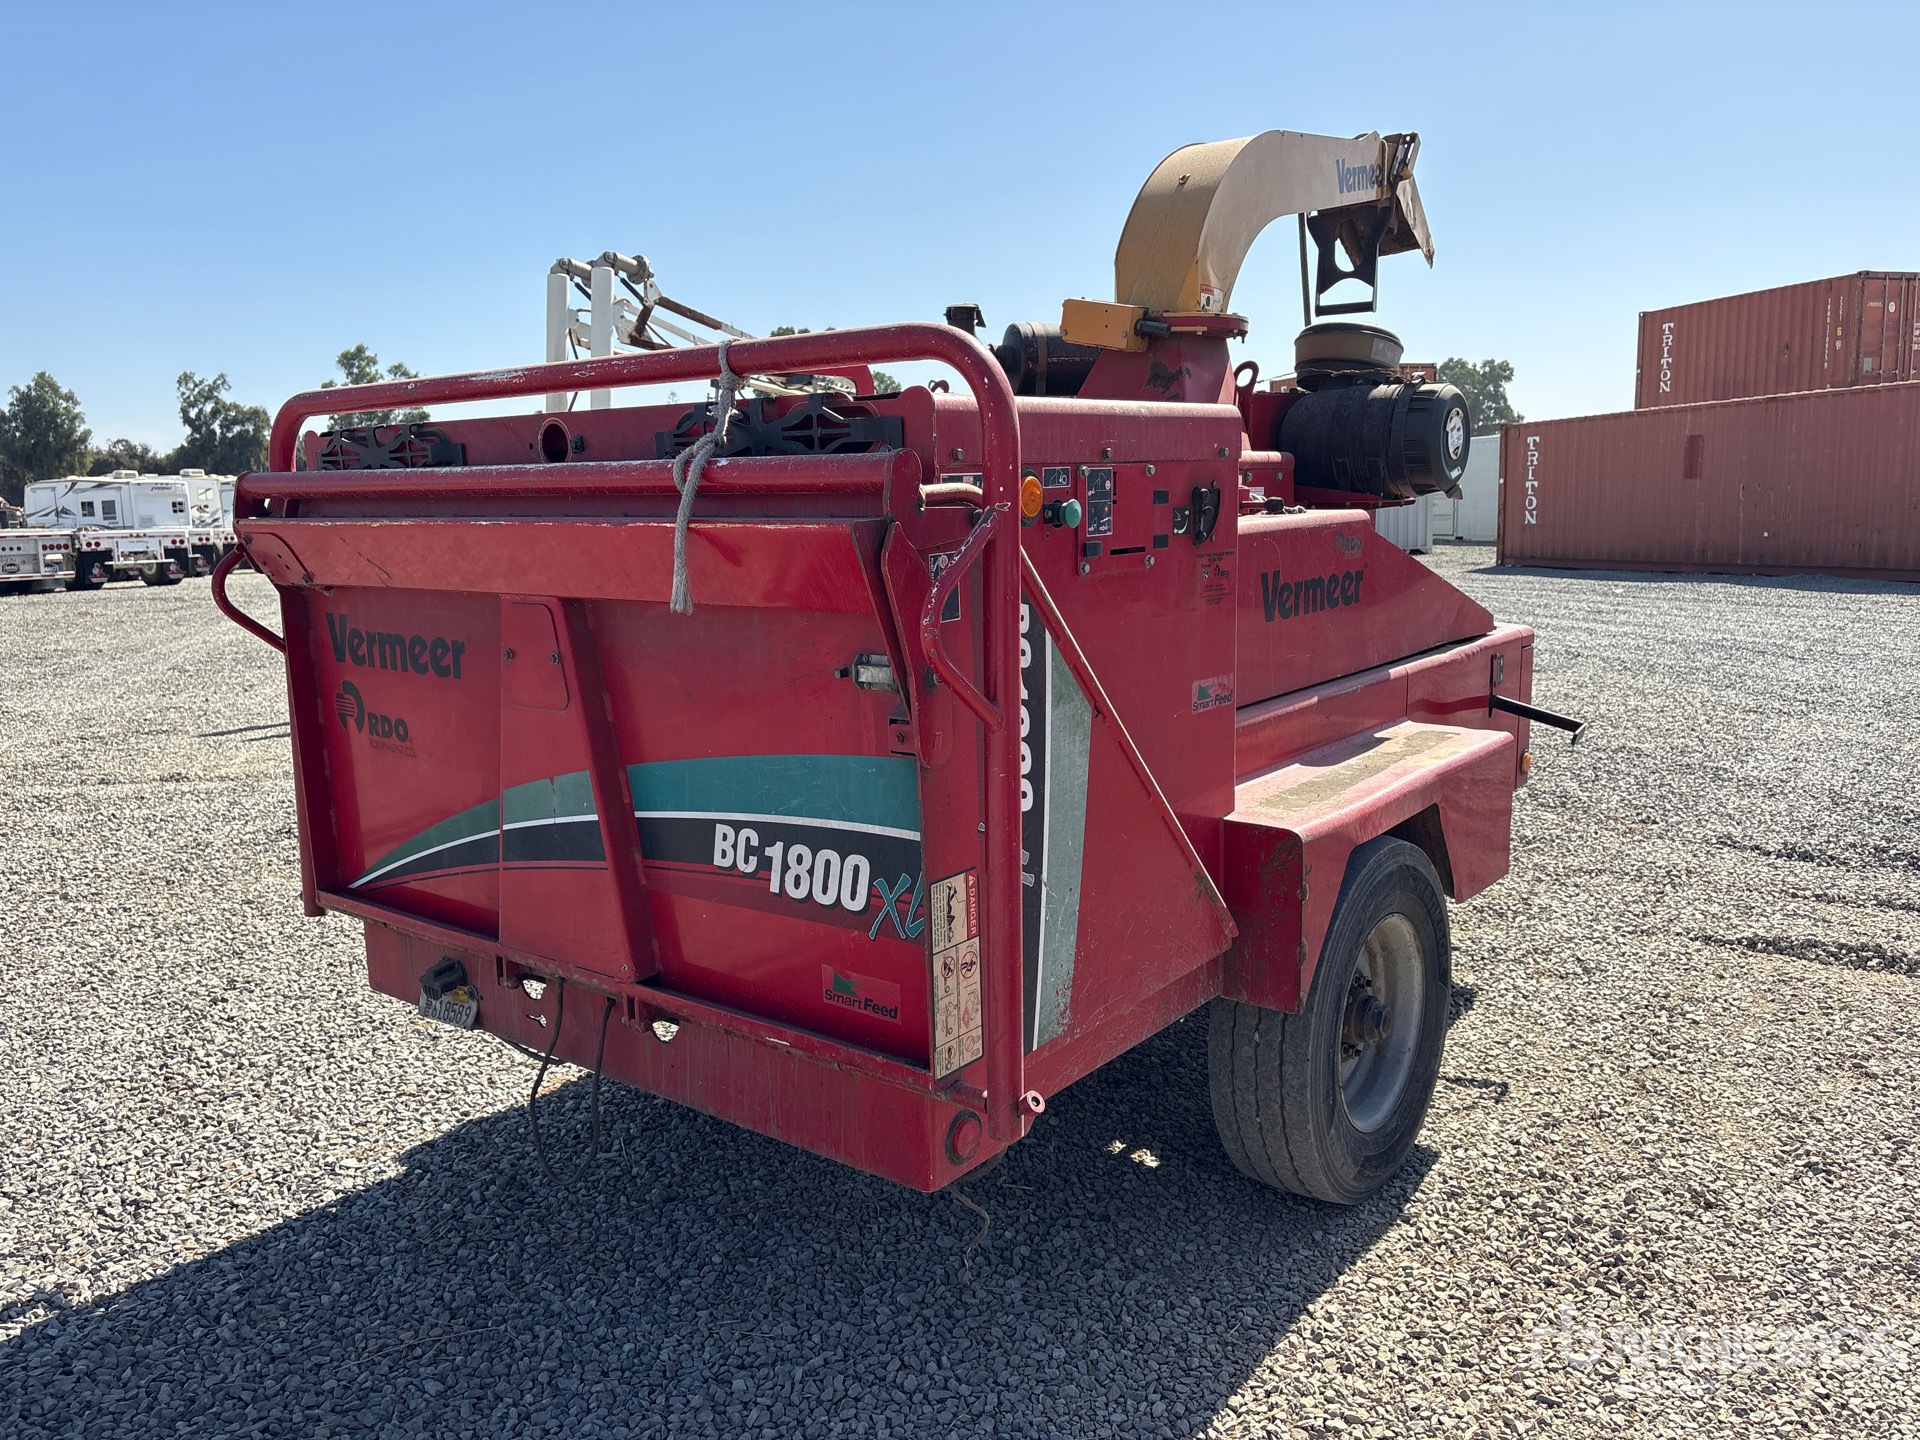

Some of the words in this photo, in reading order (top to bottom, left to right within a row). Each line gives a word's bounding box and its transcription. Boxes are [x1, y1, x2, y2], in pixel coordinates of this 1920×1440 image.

[1336, 158, 1385, 194] Vermee
[1659, 322, 1675, 393] TRITON
[1524, 436, 1540, 525] TRITON
[1260, 570, 1364, 623] Vermeer
[325, 612, 466, 680] Vermeer
[367, 712, 409, 743] RDO
[713, 823, 759, 873] BC
[765, 841, 871, 912] 1800
[868, 870, 925, 940] XL
[968, 888, 977, 935] DANGER
